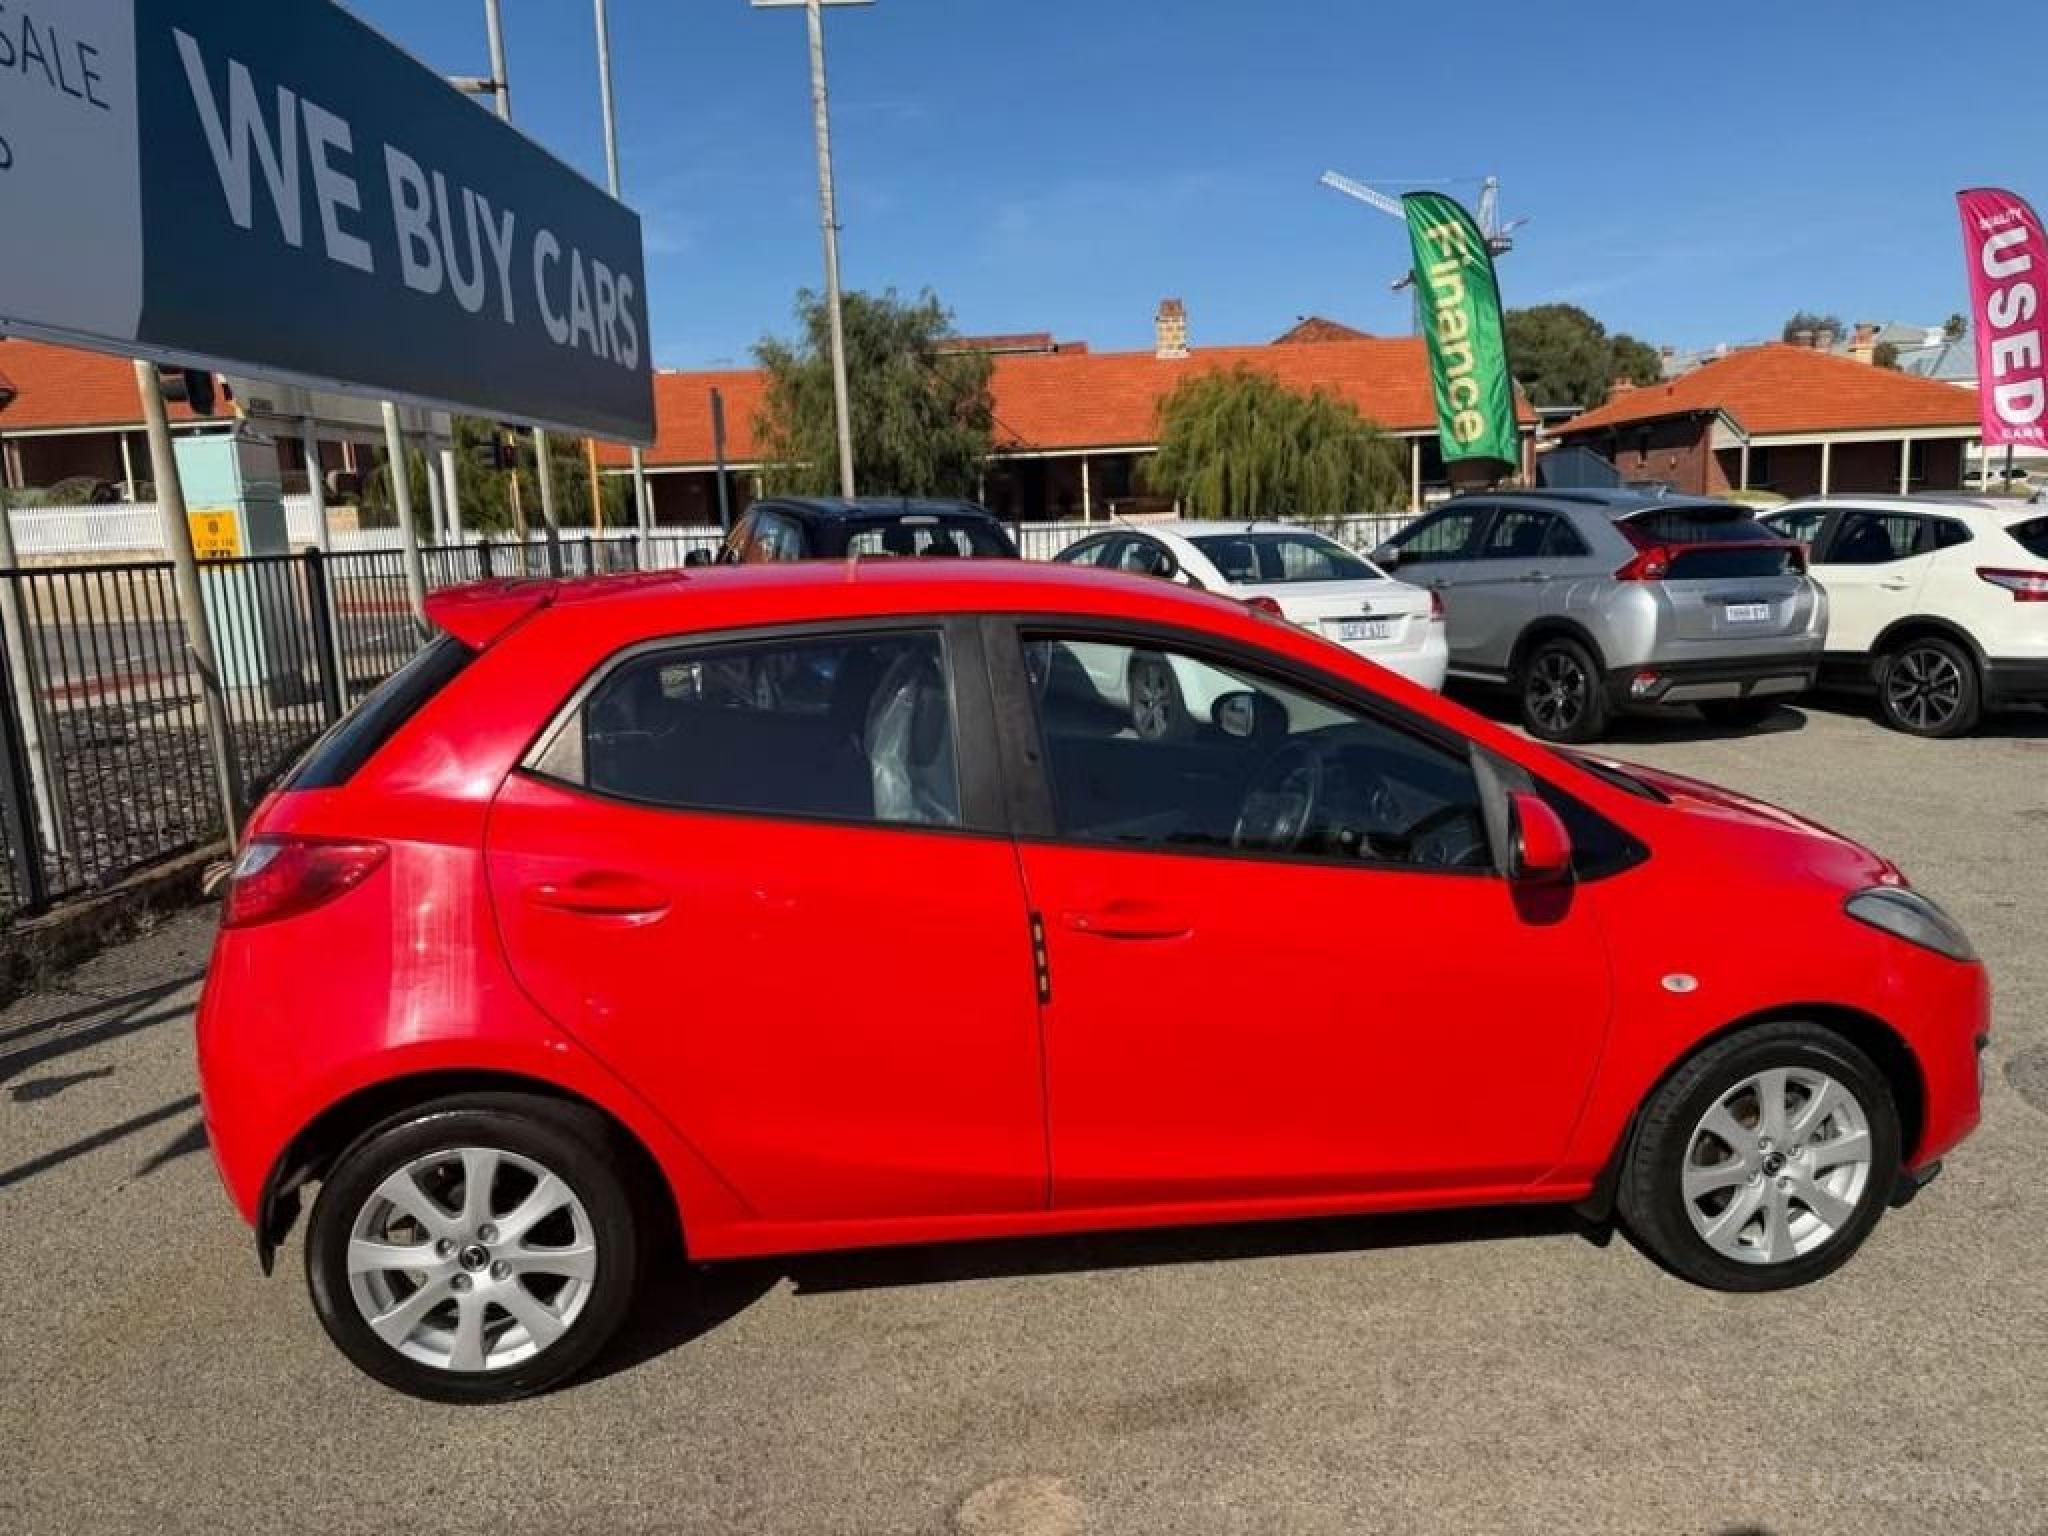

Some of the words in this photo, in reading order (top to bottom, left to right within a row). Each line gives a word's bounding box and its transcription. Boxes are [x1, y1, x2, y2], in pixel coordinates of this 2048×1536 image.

[173, 26, 375, 274] WE
[383, 142, 516, 325] BUY
[532, 228, 640, 371] CARS
[1427, 220, 1485, 444] Finance
[1982, 226, 2046, 426] USED
